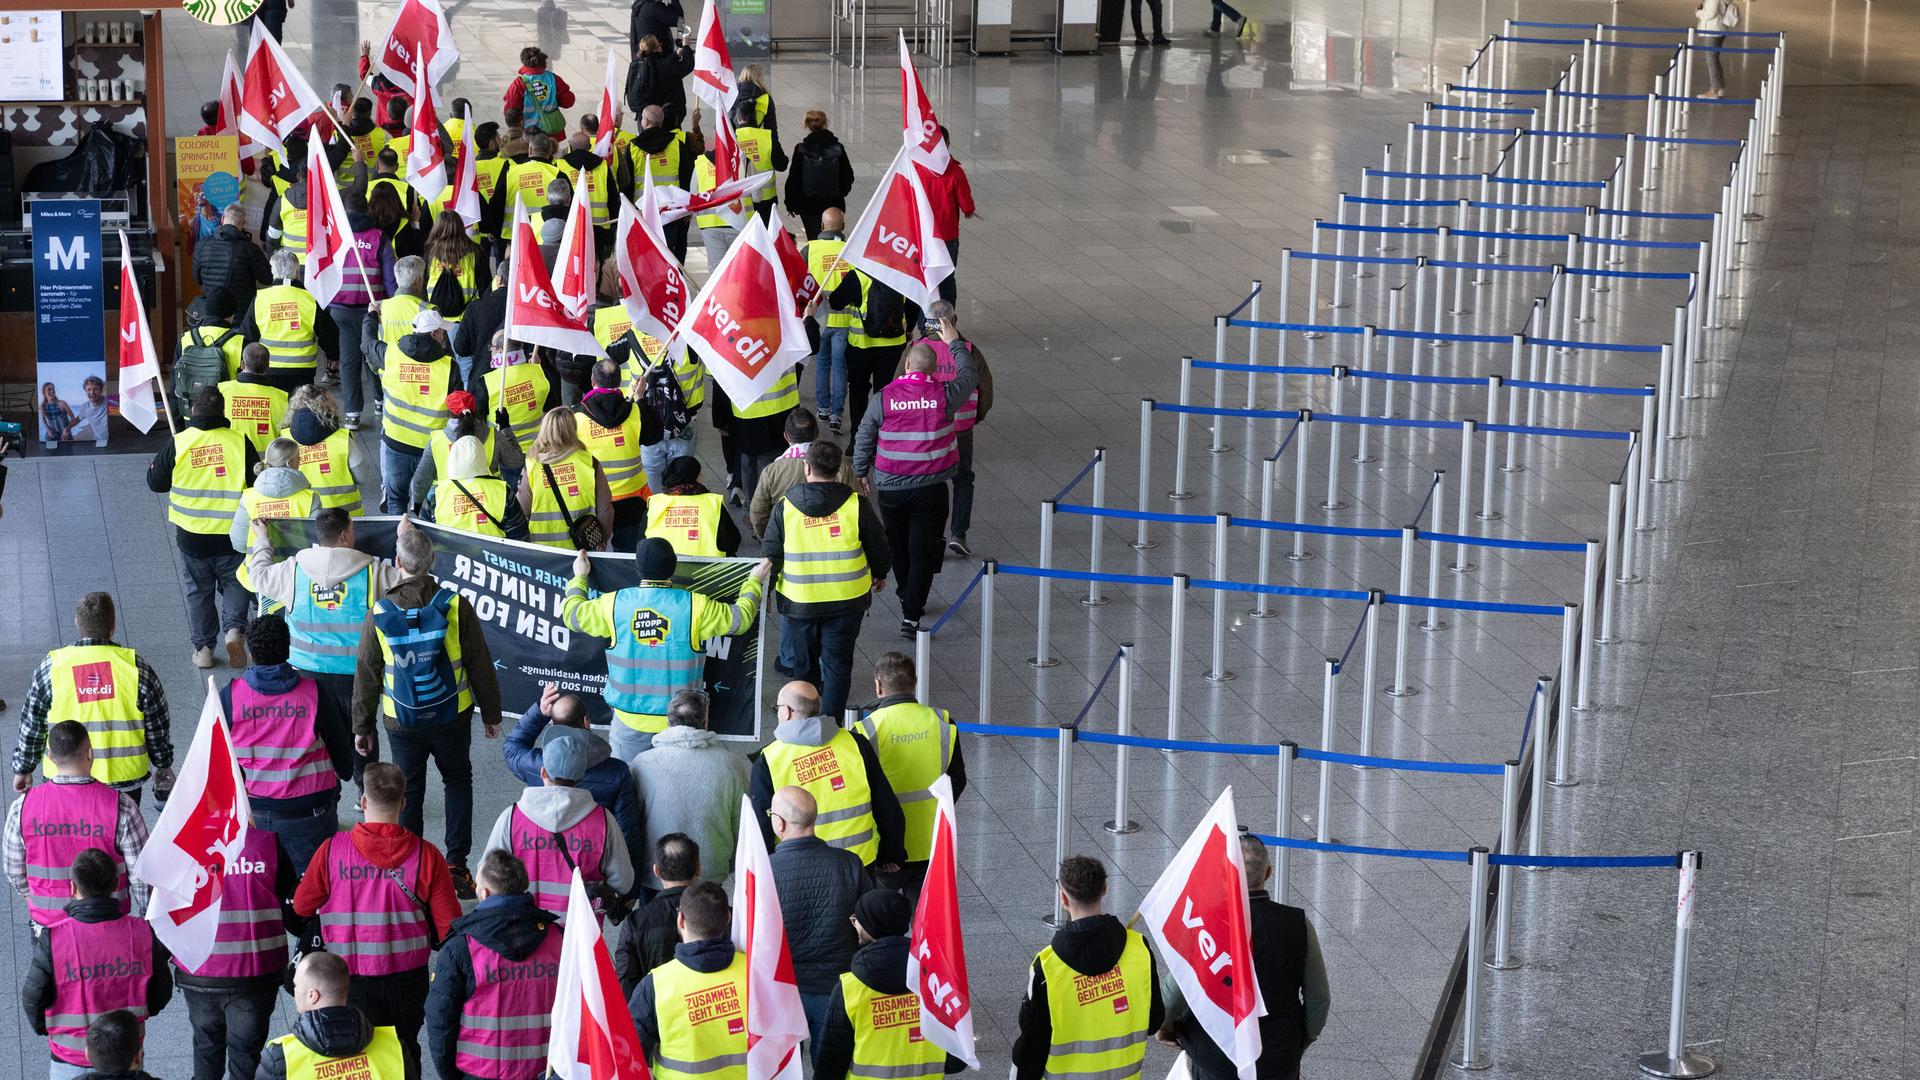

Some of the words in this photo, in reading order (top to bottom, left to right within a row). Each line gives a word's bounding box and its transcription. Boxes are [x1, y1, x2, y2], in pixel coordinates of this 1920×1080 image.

[180, 141, 220, 150] COLORFUL
[180, 152, 228, 161] SPRINGTIME
[180, 164, 215, 173] SPECIALS
[878, 224, 919, 264] ver.
[44, 236, 90, 270] M
[270, 303, 299, 312] ZUSAMMEN
[284, 310, 299, 318] MEHR
[706, 296, 770, 366] ver.di
[400, 364, 430, 374] ZUSAMMEN
[506, 384, 533, 396] ZUSAMMEN
[232, 398, 270, 408] ZUSAMMEN
[507, 394, 521, 404] GEHT
[521, 390, 535, 400] MEHR
[890, 397, 937, 410] komba
[232, 408, 251, 417] GEHT
[252, 408, 269, 417] MEHR
[590, 428, 605, 437] GEHT
[190, 446, 223, 458] ZUSAMMEN
[300, 454, 312, 462] EHT
[313, 451, 328, 460] MEHR
[191, 456, 208, 465] GEHT
[208, 453, 224, 463] MEHR
[560, 474, 576, 482] MEHR
[257, 503, 289, 513] ZUSAMMEN
[804, 516, 821, 526] GEHT
[822, 513, 839, 523] MEHR
[638, 611, 650, 620] UN
[635, 619, 662, 628] STOPP
[639, 629, 656, 637] BAR
[78, 684, 112, 695] ver.di
[242, 701, 306, 720] komba
[890, 730, 929, 746] Fraport
[794, 750, 836, 772] ZUSAMMEN
[797, 768, 817, 783] GEHT
[818, 759, 839, 774] MEHR
[32, 818, 104, 838] komba
[228, 856, 265, 875] mba
[1182, 896, 1233, 988] ver.
[66, 956, 143, 982] komba
[485, 960, 557, 984] komba
[920, 938, 962, 1016] r.di
[1074, 966, 1122, 991] ZUSAMMEN
[687, 985, 738, 1009] ZUSAMMEN
[1077, 986, 1099, 1003] GEHT
[1101, 978, 1125, 994] MEHR
[688, 1008, 712, 1022] GEHT
[716, 999, 740, 1015] MEHR
[873, 1012, 896, 1026] GEHT
[315, 1056, 369, 1080] ZUSAMMEN
